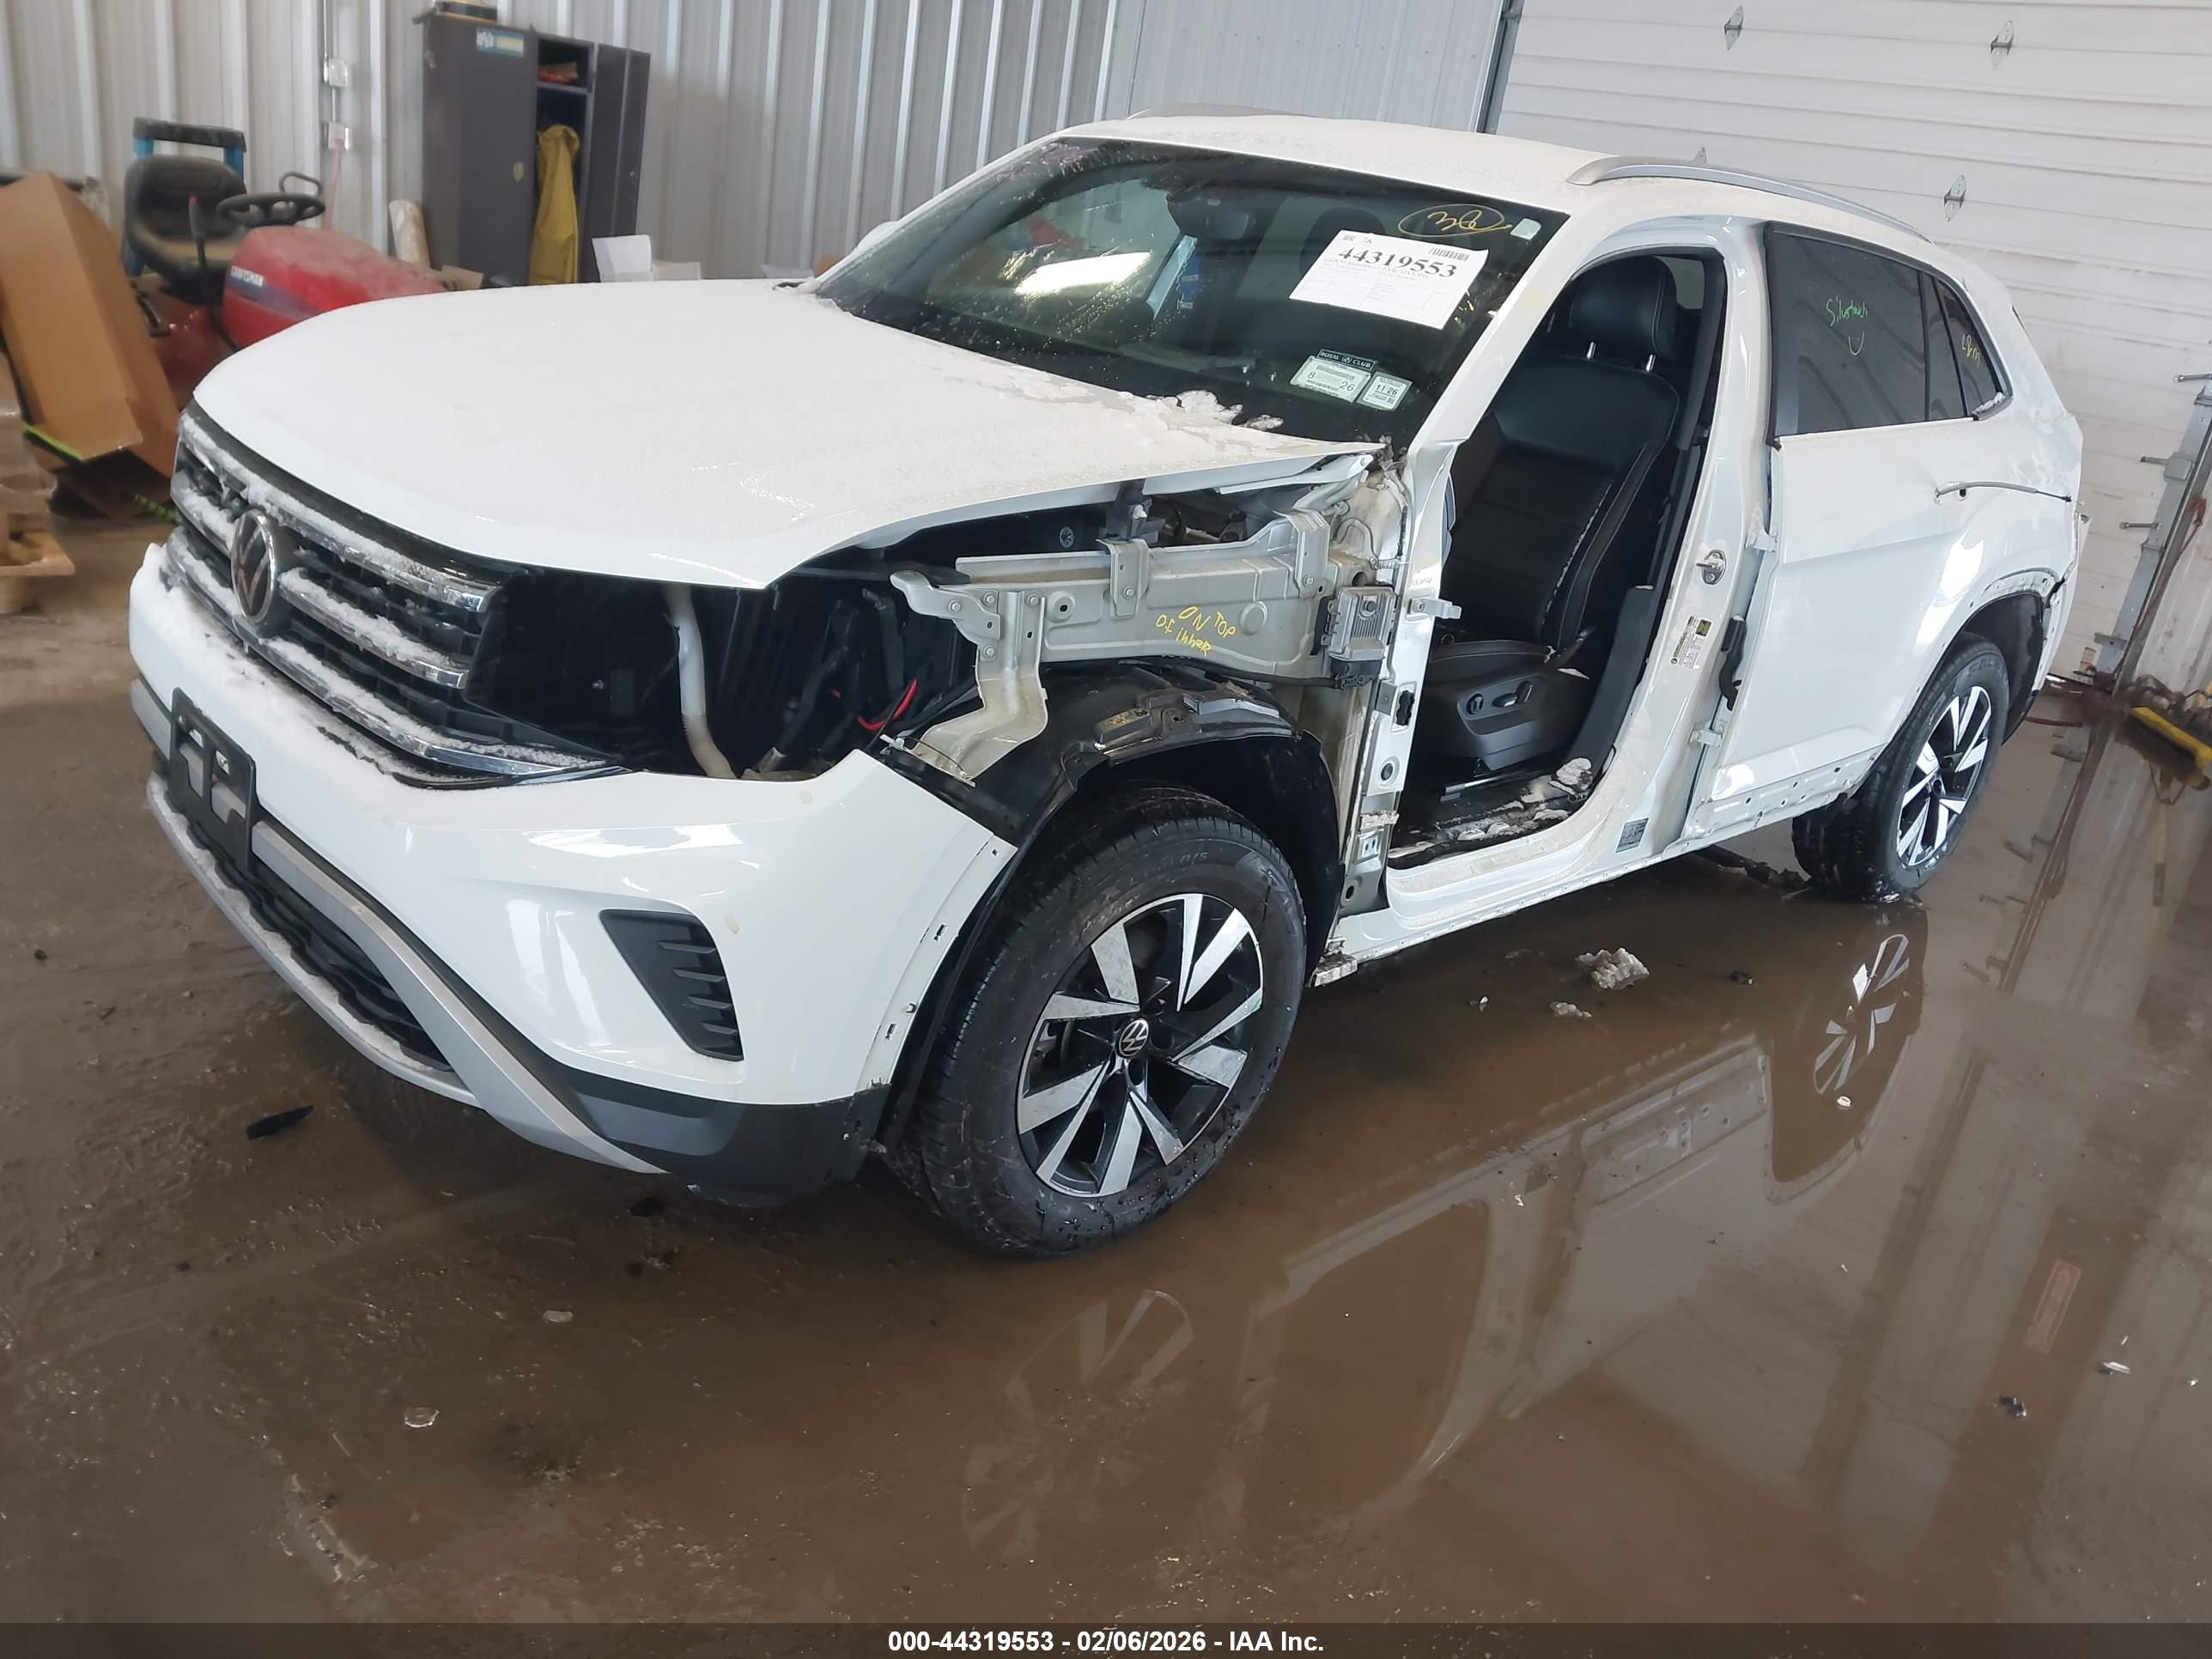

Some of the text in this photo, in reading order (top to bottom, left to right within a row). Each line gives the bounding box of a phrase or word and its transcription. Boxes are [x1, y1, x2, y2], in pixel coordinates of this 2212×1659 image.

[1338, 246, 1457, 278] 44319553
[1320, 351, 1371, 368] ROYAL CLUB
[1307, 370, 1316, 379] 8
[1340, 381, 1356, 392] 26
[1387, 387, 1400, 396] 26
[1178, 605, 1237, 639] ON TOP
